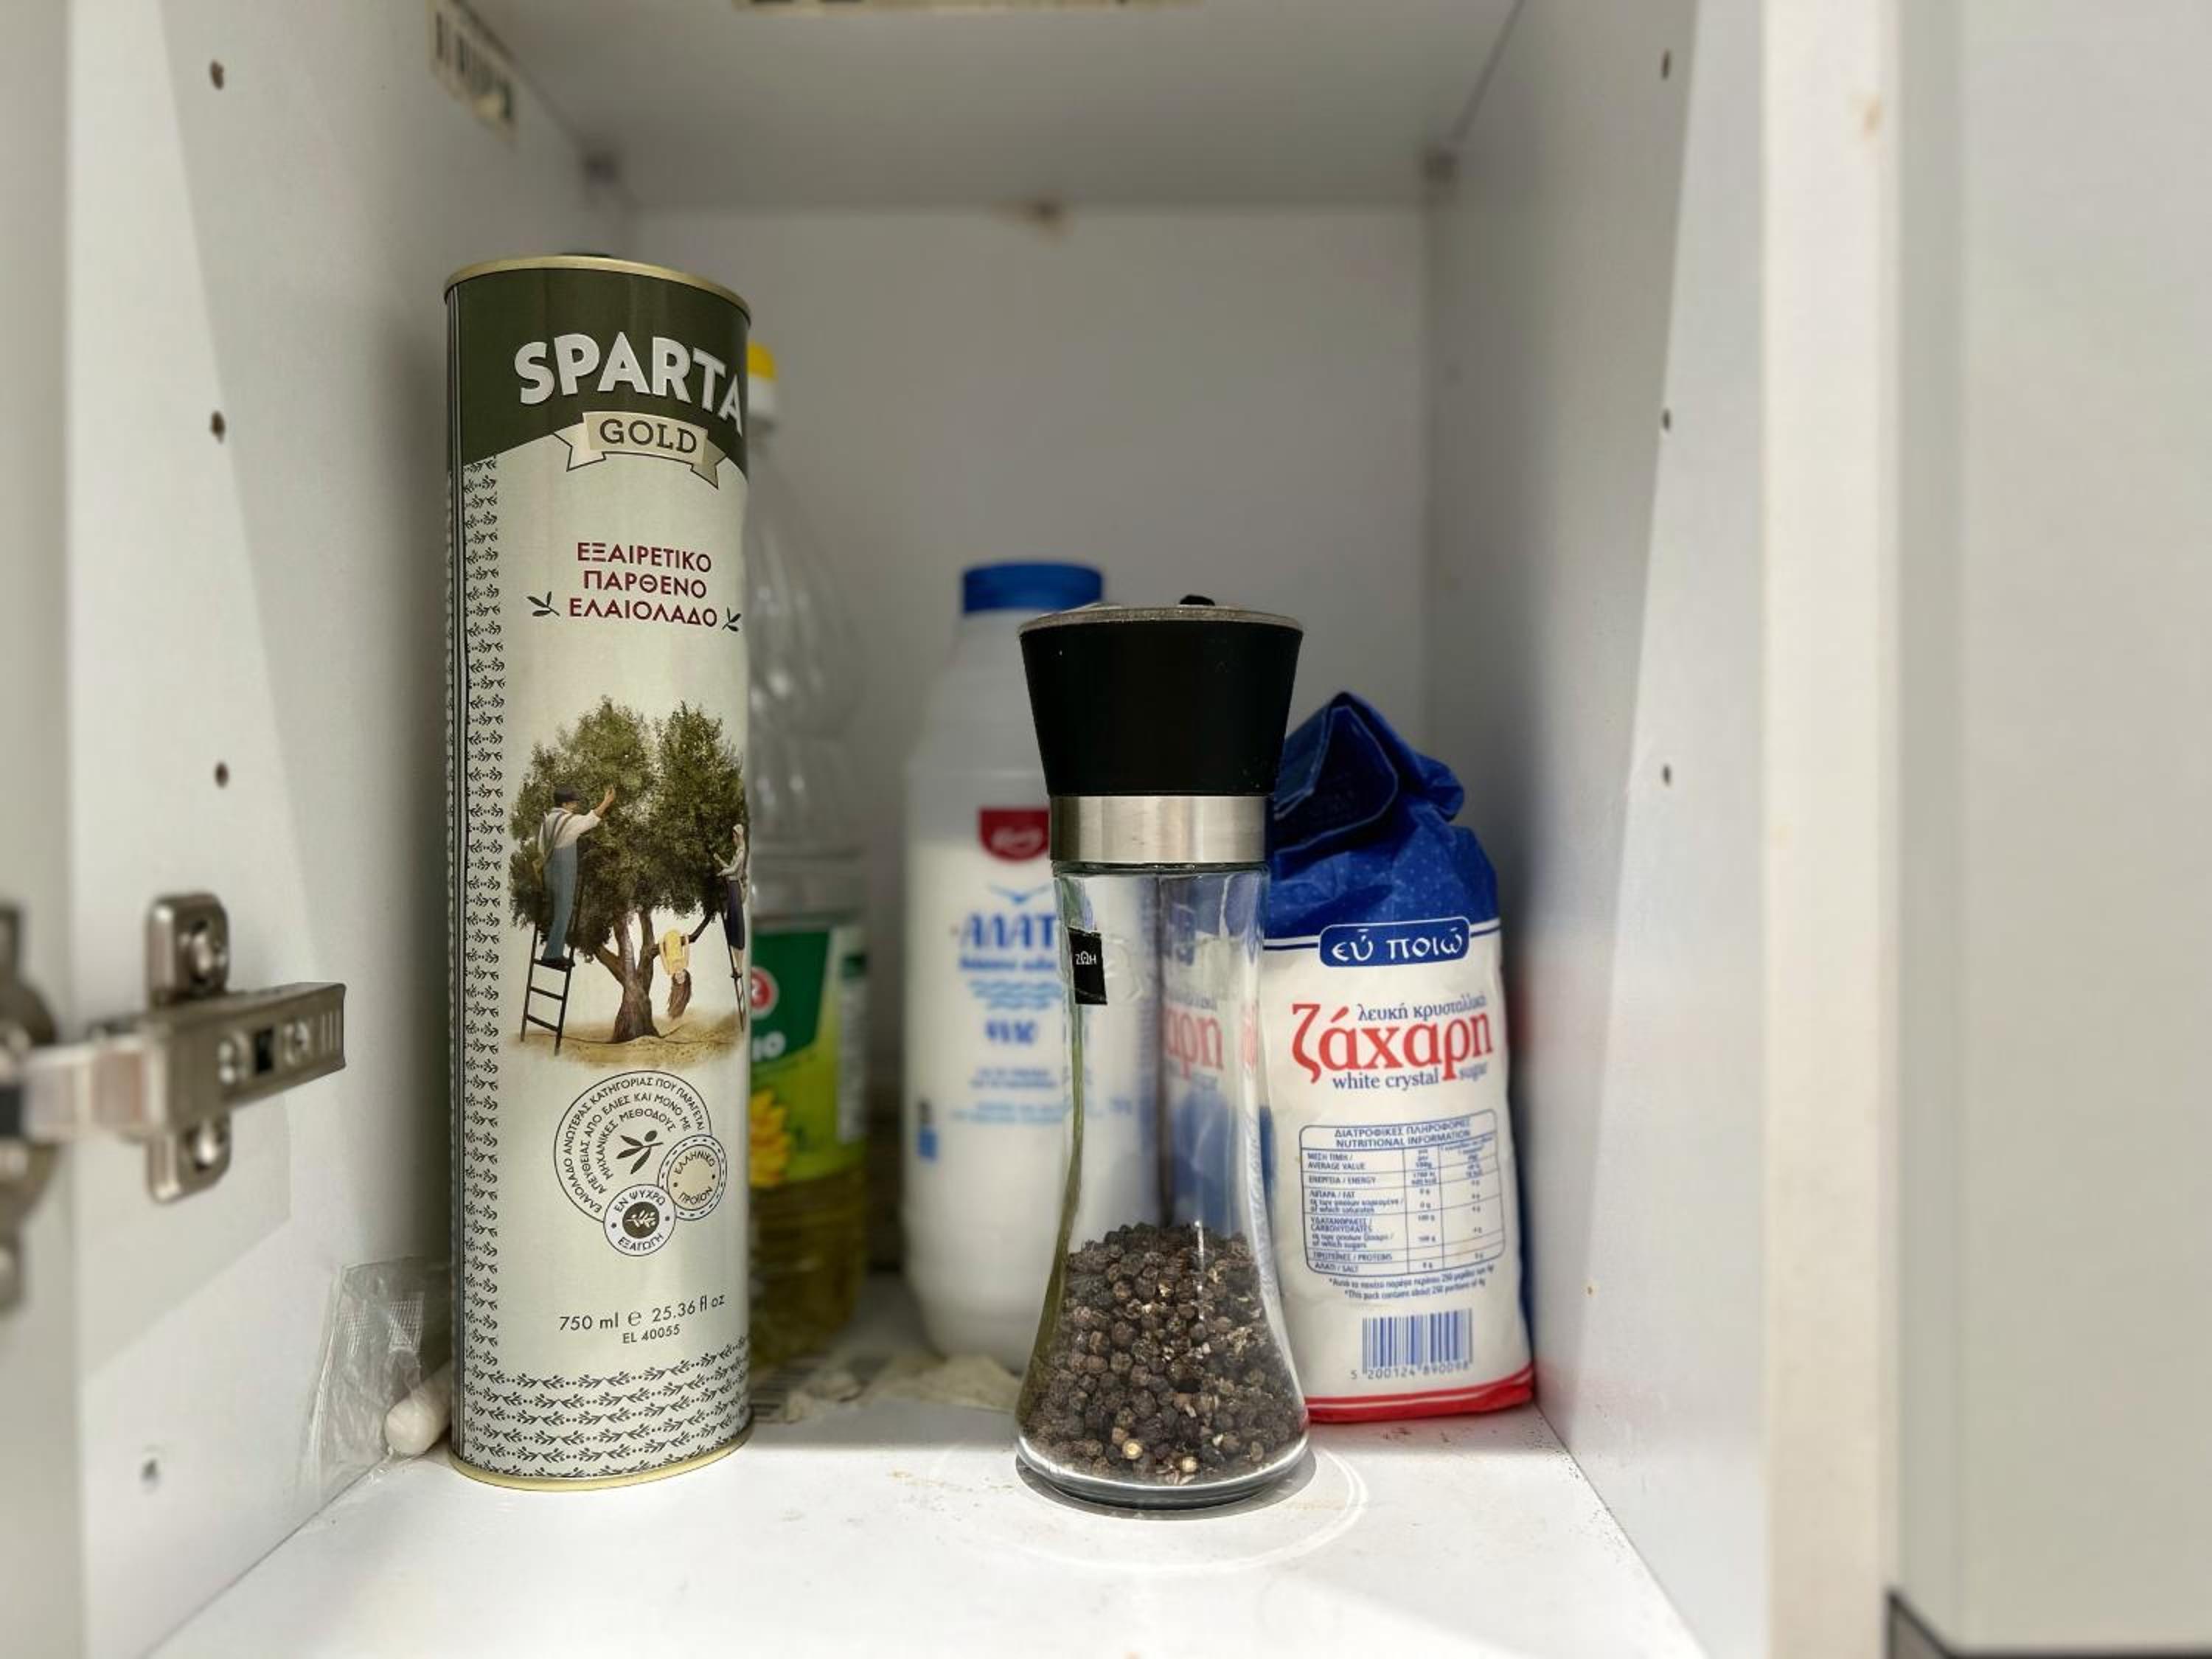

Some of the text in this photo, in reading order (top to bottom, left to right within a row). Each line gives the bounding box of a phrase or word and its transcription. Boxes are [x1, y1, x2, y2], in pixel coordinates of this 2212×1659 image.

[514, 331, 742, 437] SPARTA
[599, 419, 698, 454] GOLD
[577, 542, 712, 573] ΕΞΑΙΡΕΤΙΚΟ
[583, 570, 707, 599] ΠΑΡΘΕΝΟ
[569, 597, 717, 627] ΕΛΑΙΟΛΑΔΟ
[1292, 1004, 1494, 1084] ζάχαρη
[655, 1078, 677, 1092] ΠΟΥ
[1332, 1072, 1381, 1090] white
[1385, 1068, 1439, 1091] crystal
[588, 1114, 602, 1138] ΑΠΟ
[633, 1092, 652, 1102] ΚΑΙ
[654, 1094, 683, 1116] ΜΟΝΟ
[614, 1197, 629, 1213] ΕΝ
[559, 1315, 592, 1330] 750
[599, 1312, 619, 1329] ml
[652, 1300, 695, 1322] 25.36
[711, 1295, 725, 1307] oz
[622, 1324, 680, 1343] EL 40055
